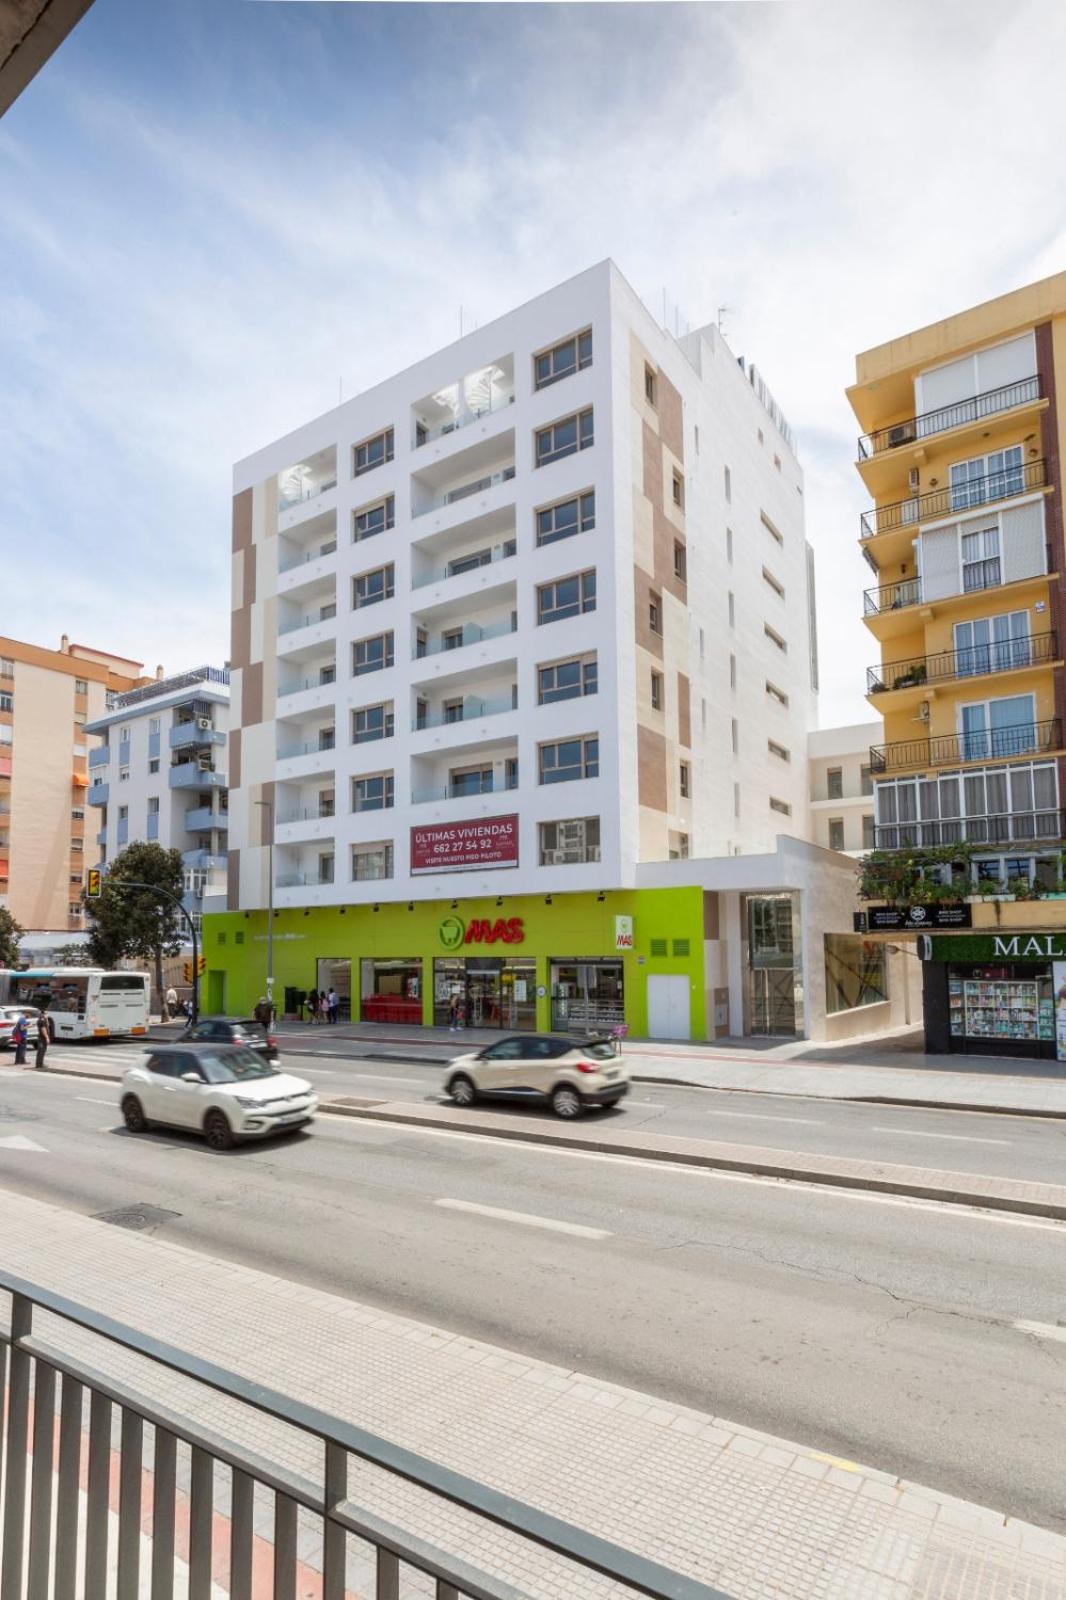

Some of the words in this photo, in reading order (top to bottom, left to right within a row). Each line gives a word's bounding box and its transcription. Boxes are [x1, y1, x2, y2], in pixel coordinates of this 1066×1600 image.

[415, 830, 456, 843] ÚLTIMAS
[457, 824, 513, 838] VIVIENDAS
[451, 842, 462, 852] 27
[465, 840, 477, 850] 54
[480, 838, 492, 849] 92
[464, 917, 524, 944] MAS
[617, 934, 633, 946] MAS
[992, 935, 1066, 957] MAL
